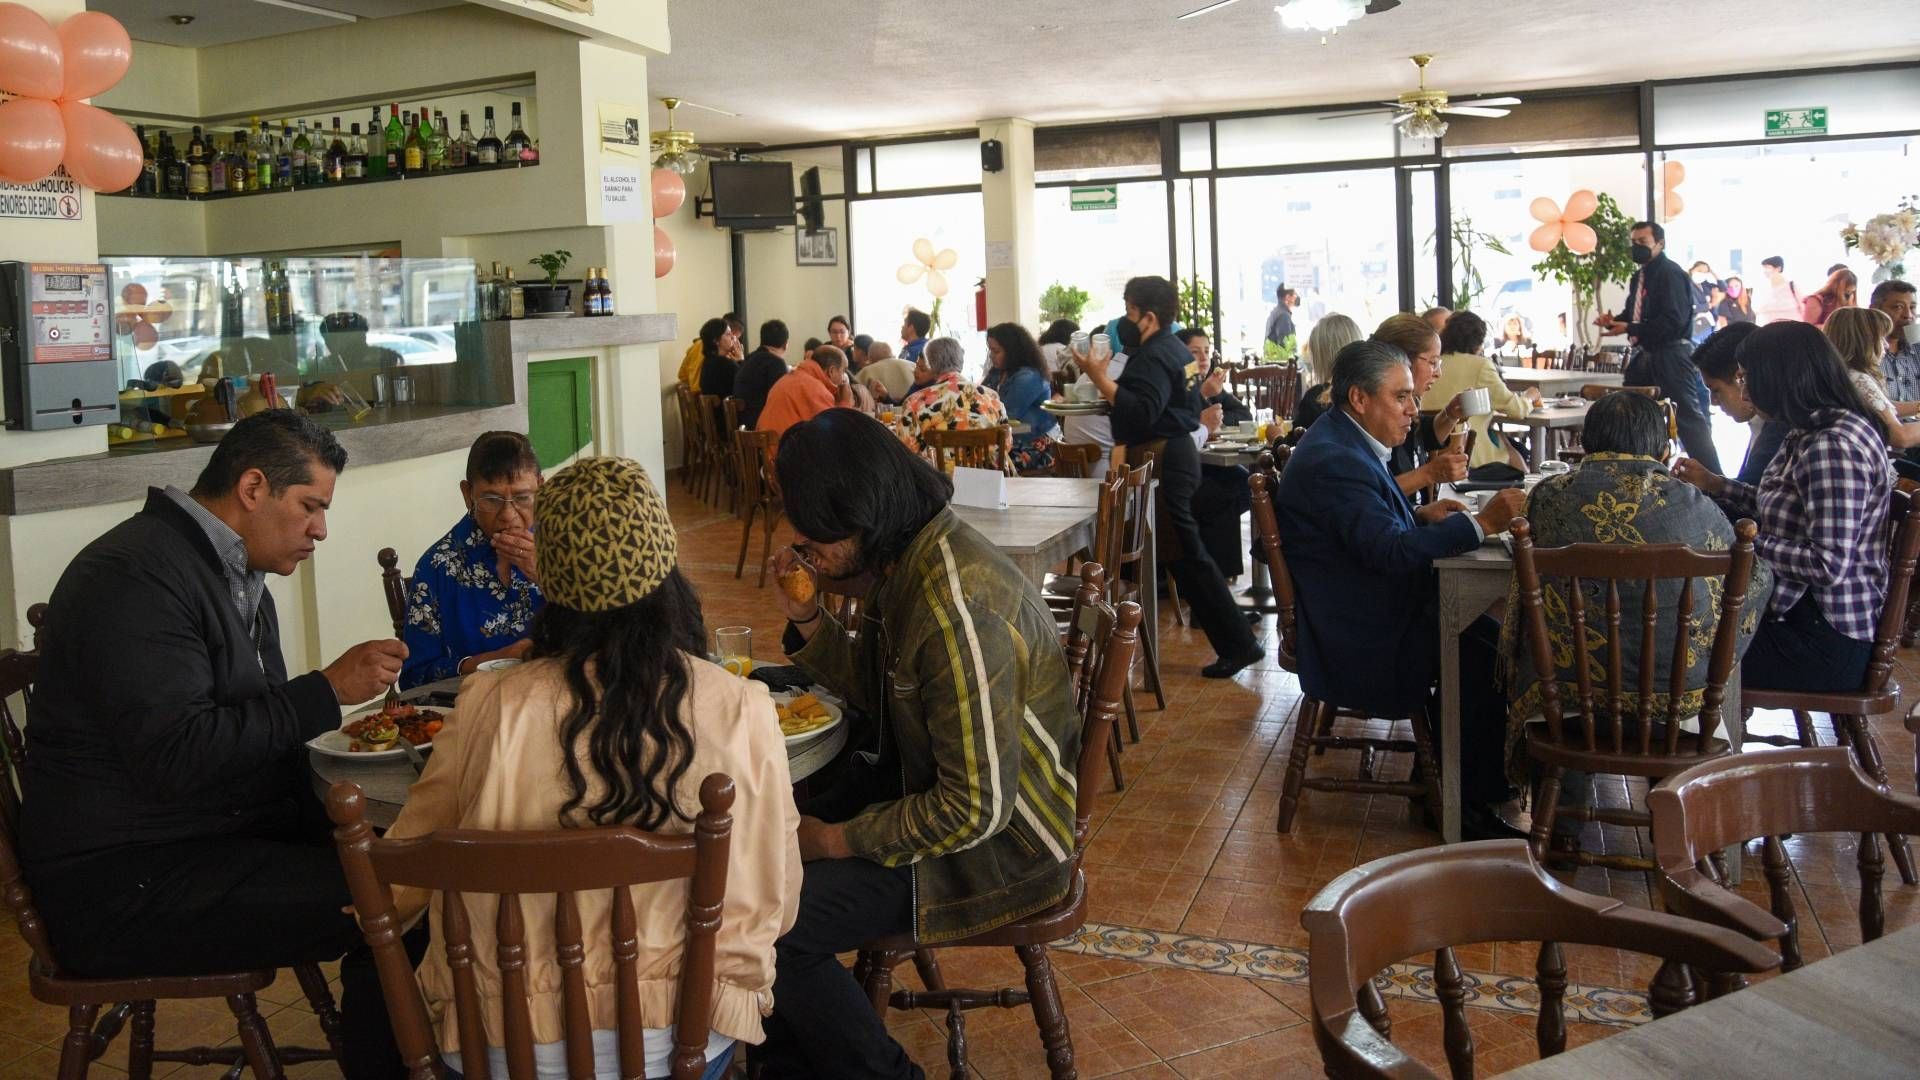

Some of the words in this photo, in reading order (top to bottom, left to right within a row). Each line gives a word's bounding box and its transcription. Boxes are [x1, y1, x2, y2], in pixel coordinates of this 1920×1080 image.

[0, 195, 27, 214] ENORES
[28, 196, 38, 215] DE
[39, 196, 58, 216] EDAD
